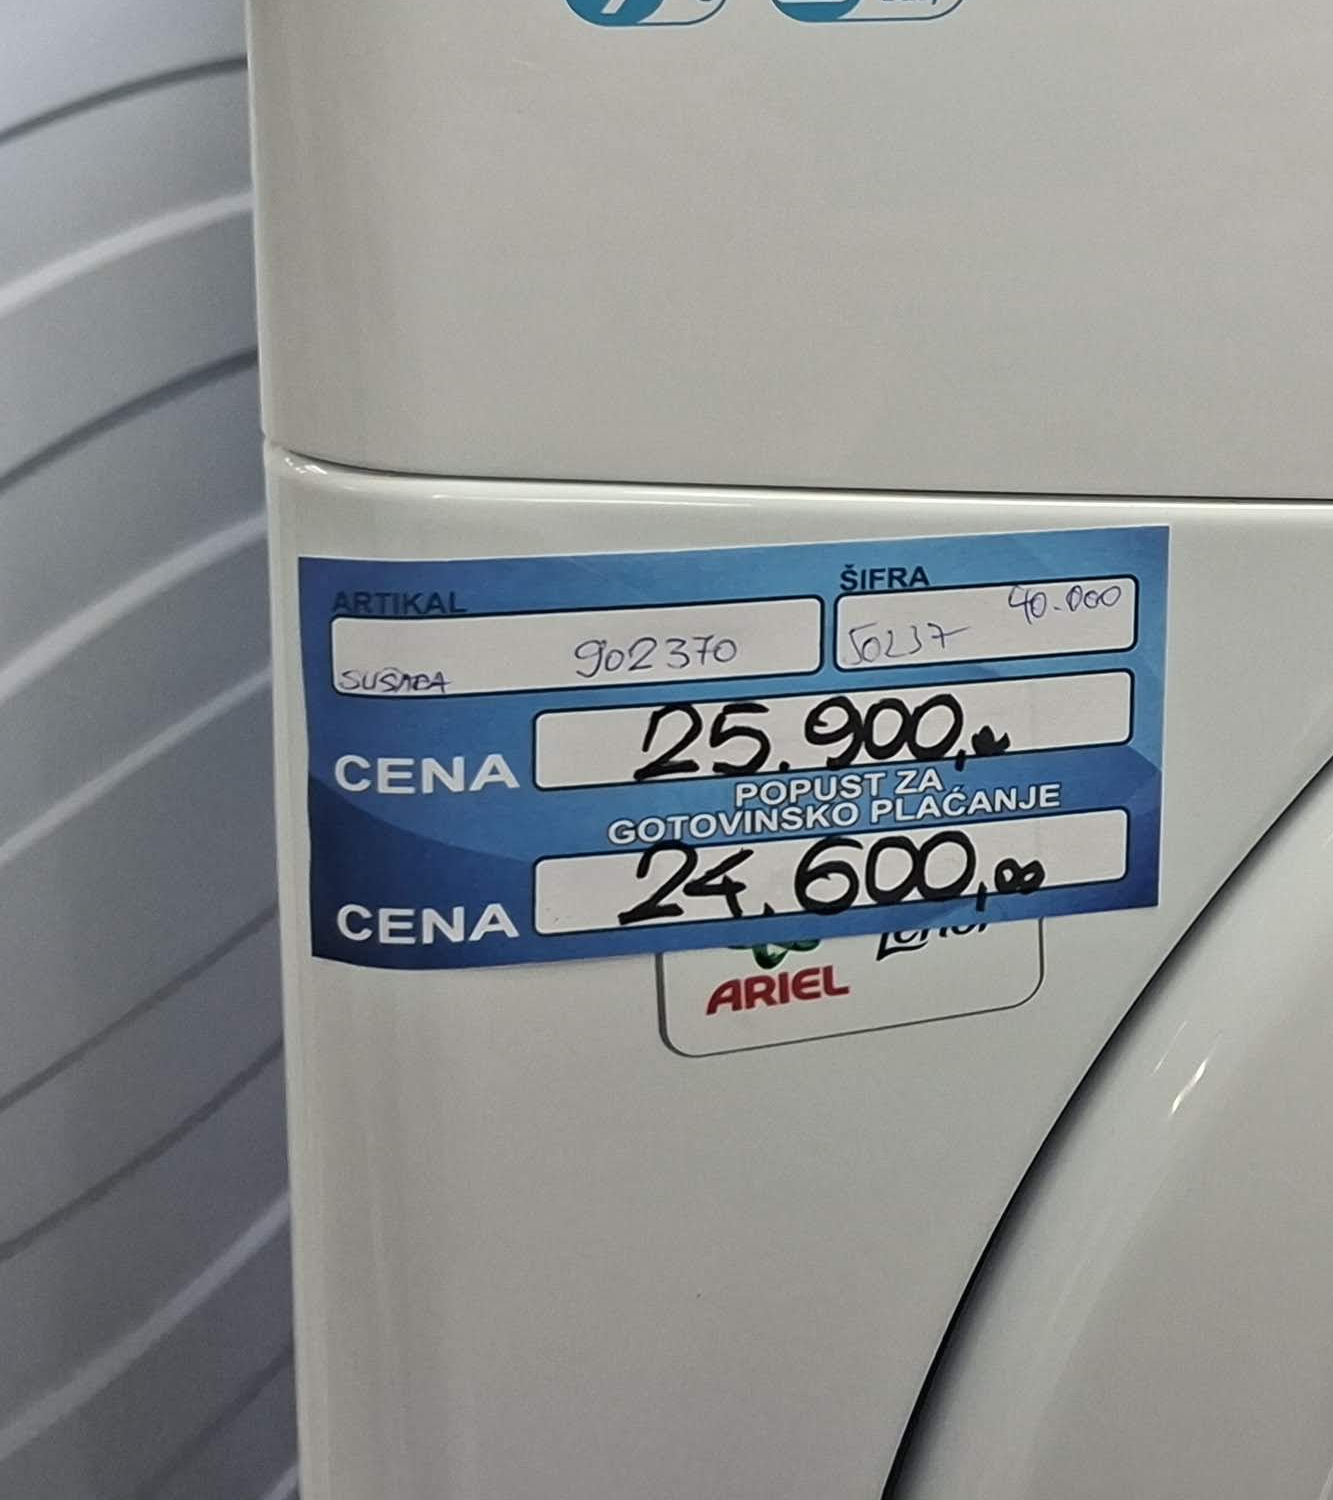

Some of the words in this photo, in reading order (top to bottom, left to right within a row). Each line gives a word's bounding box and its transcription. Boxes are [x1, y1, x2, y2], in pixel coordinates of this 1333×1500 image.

[839, 564, 930, 592] ŠIFRA
[331, 591, 468, 616] ARTIKAL
[335, 754, 520, 794] CENA
[735, 772, 887, 808] POPUST
[894, 768, 944, 797] ZA
[608, 802, 860, 846] GOTOVINSKO
[871, 783, 1062, 823] PLAĆANJE
[336, 903, 520, 946] CENA
[706, 964, 850, 1016] ARIEL
